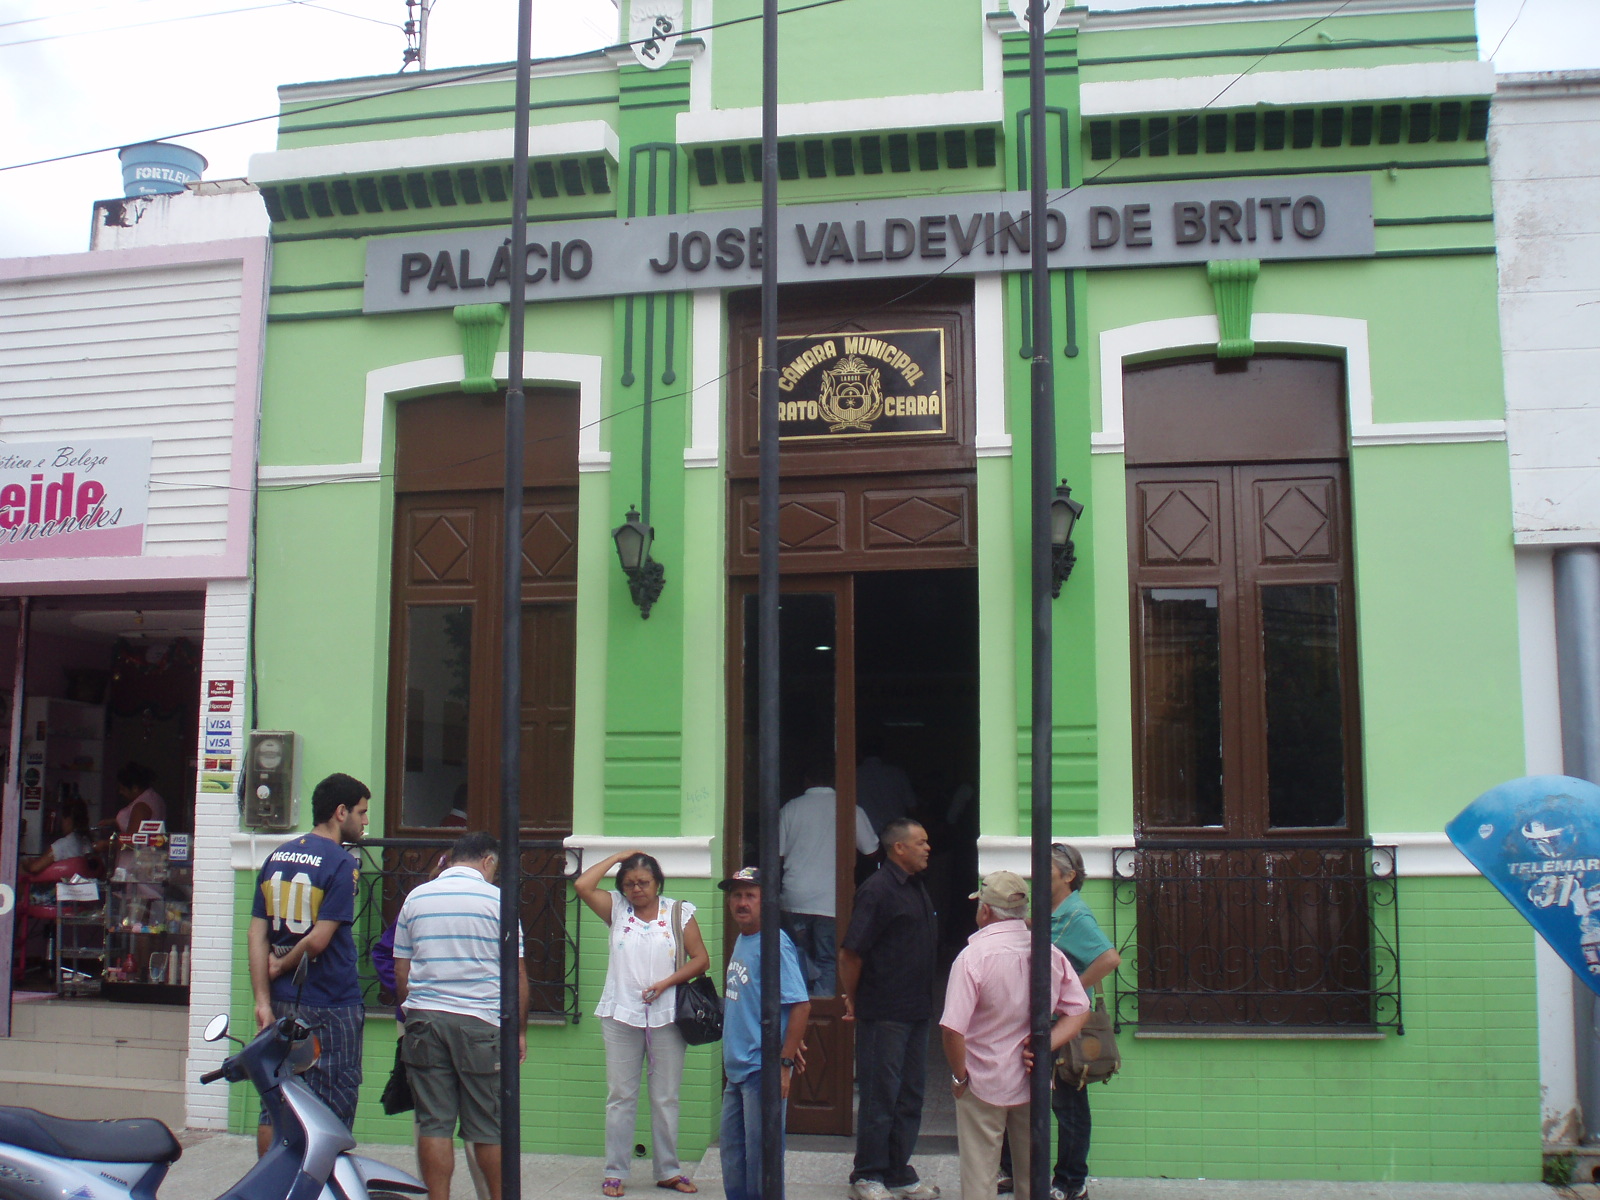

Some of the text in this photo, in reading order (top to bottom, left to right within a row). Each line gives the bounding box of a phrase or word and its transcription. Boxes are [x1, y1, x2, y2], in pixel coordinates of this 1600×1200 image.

[135, 167, 190, 184] FORTLEV
[401, 237, 593, 293] PALÁCIO
[796, 208, 1067, 265] VALDEVINO
[1090, 203, 1153, 250] DE
[1174, 195, 1326, 245] BRITO
[778, 336, 925, 392] CÂMARA MUNICIPAL
[778, 390, 940, 421] RATO CEARÁ
[34, 459, 46, 468] e
[51, 446, 108, 473] Beleza
[0, 493, 122, 545] ernandes
[210, 720, 231, 729] VISA
[209, 739, 230, 747] VISA
[270, 852, 323, 867] MEGATONE
[270, 870, 313, 935] 10
[100, 1171, 128, 1187] HONDA
